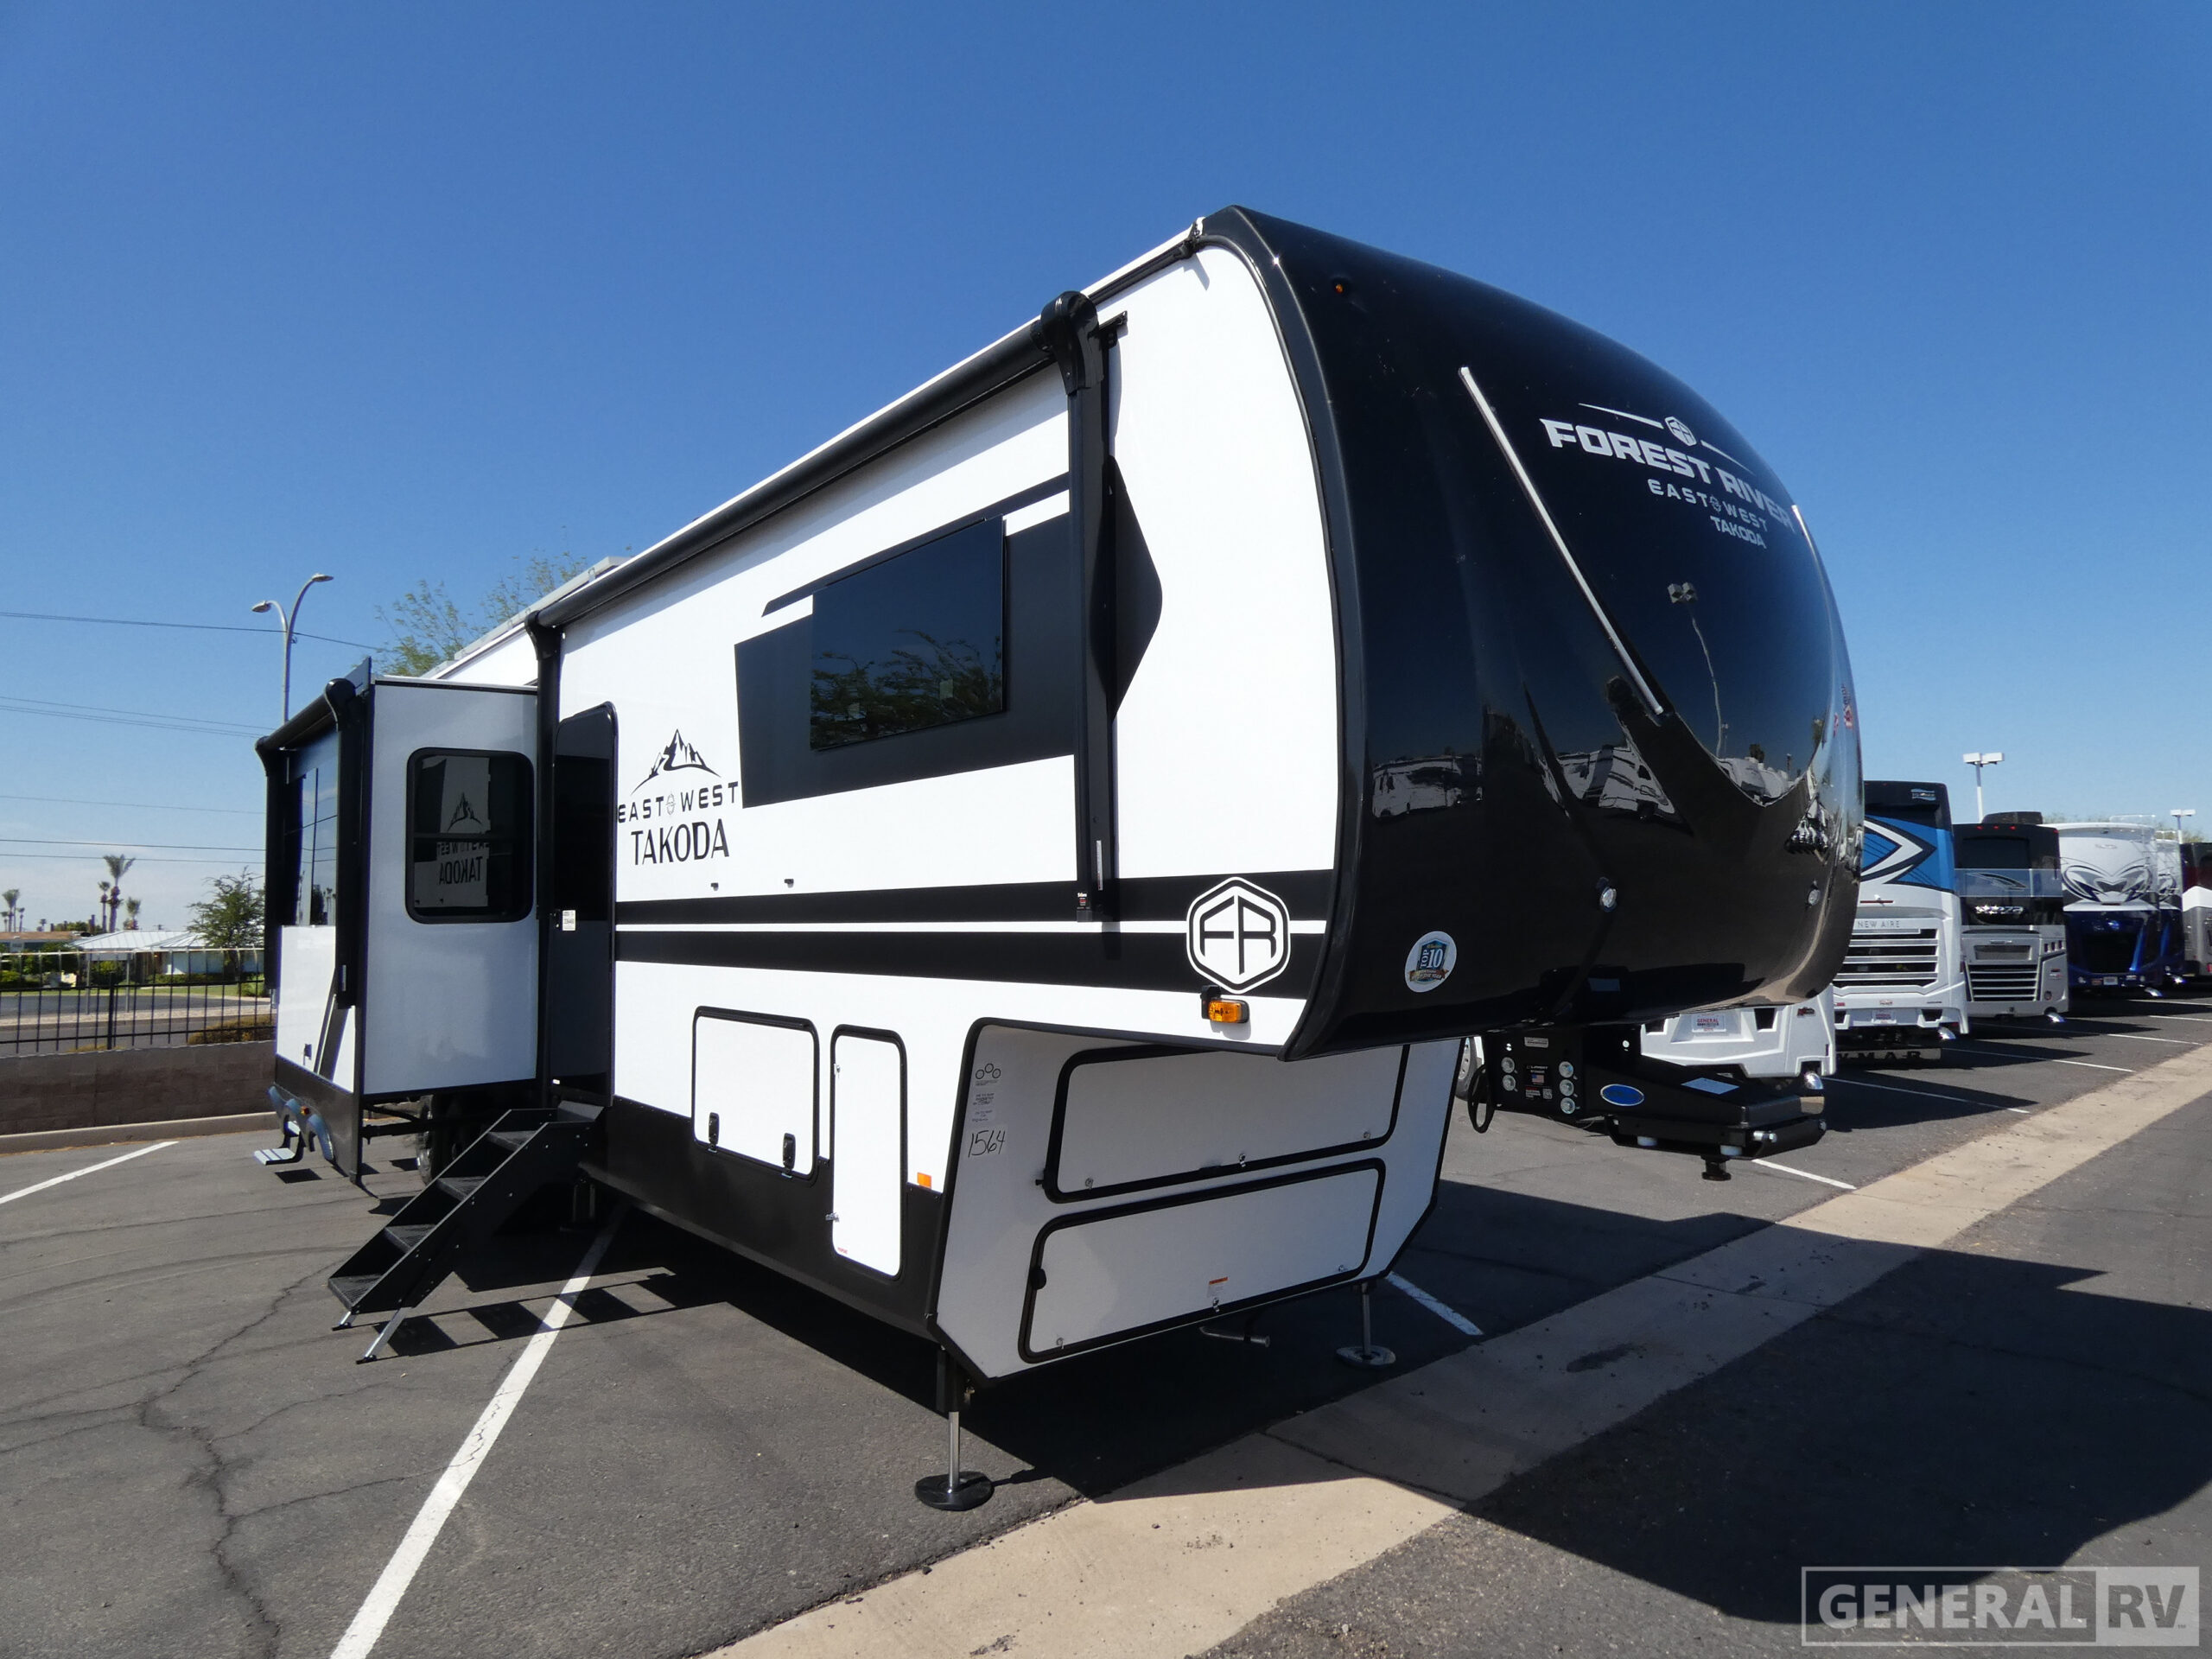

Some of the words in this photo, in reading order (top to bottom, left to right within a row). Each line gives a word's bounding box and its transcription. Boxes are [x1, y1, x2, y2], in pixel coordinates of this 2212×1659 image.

[1539, 418, 1712, 484] FOREST
[1715, 467, 1797, 533] RIVER
[1648, 479, 1709, 508] EAST
[1722, 501, 1769, 532] WEST
[1710, 516, 1767, 549] TAKODA
[618, 796, 664, 823] EAST
[680, 781, 739, 812] WEST
[631, 818, 729, 866] TAKODA
[1420, 950, 1429, 968] TOP
[1427, 949, 1443, 968] 10
[969, 1130, 1005, 1158] 1564
